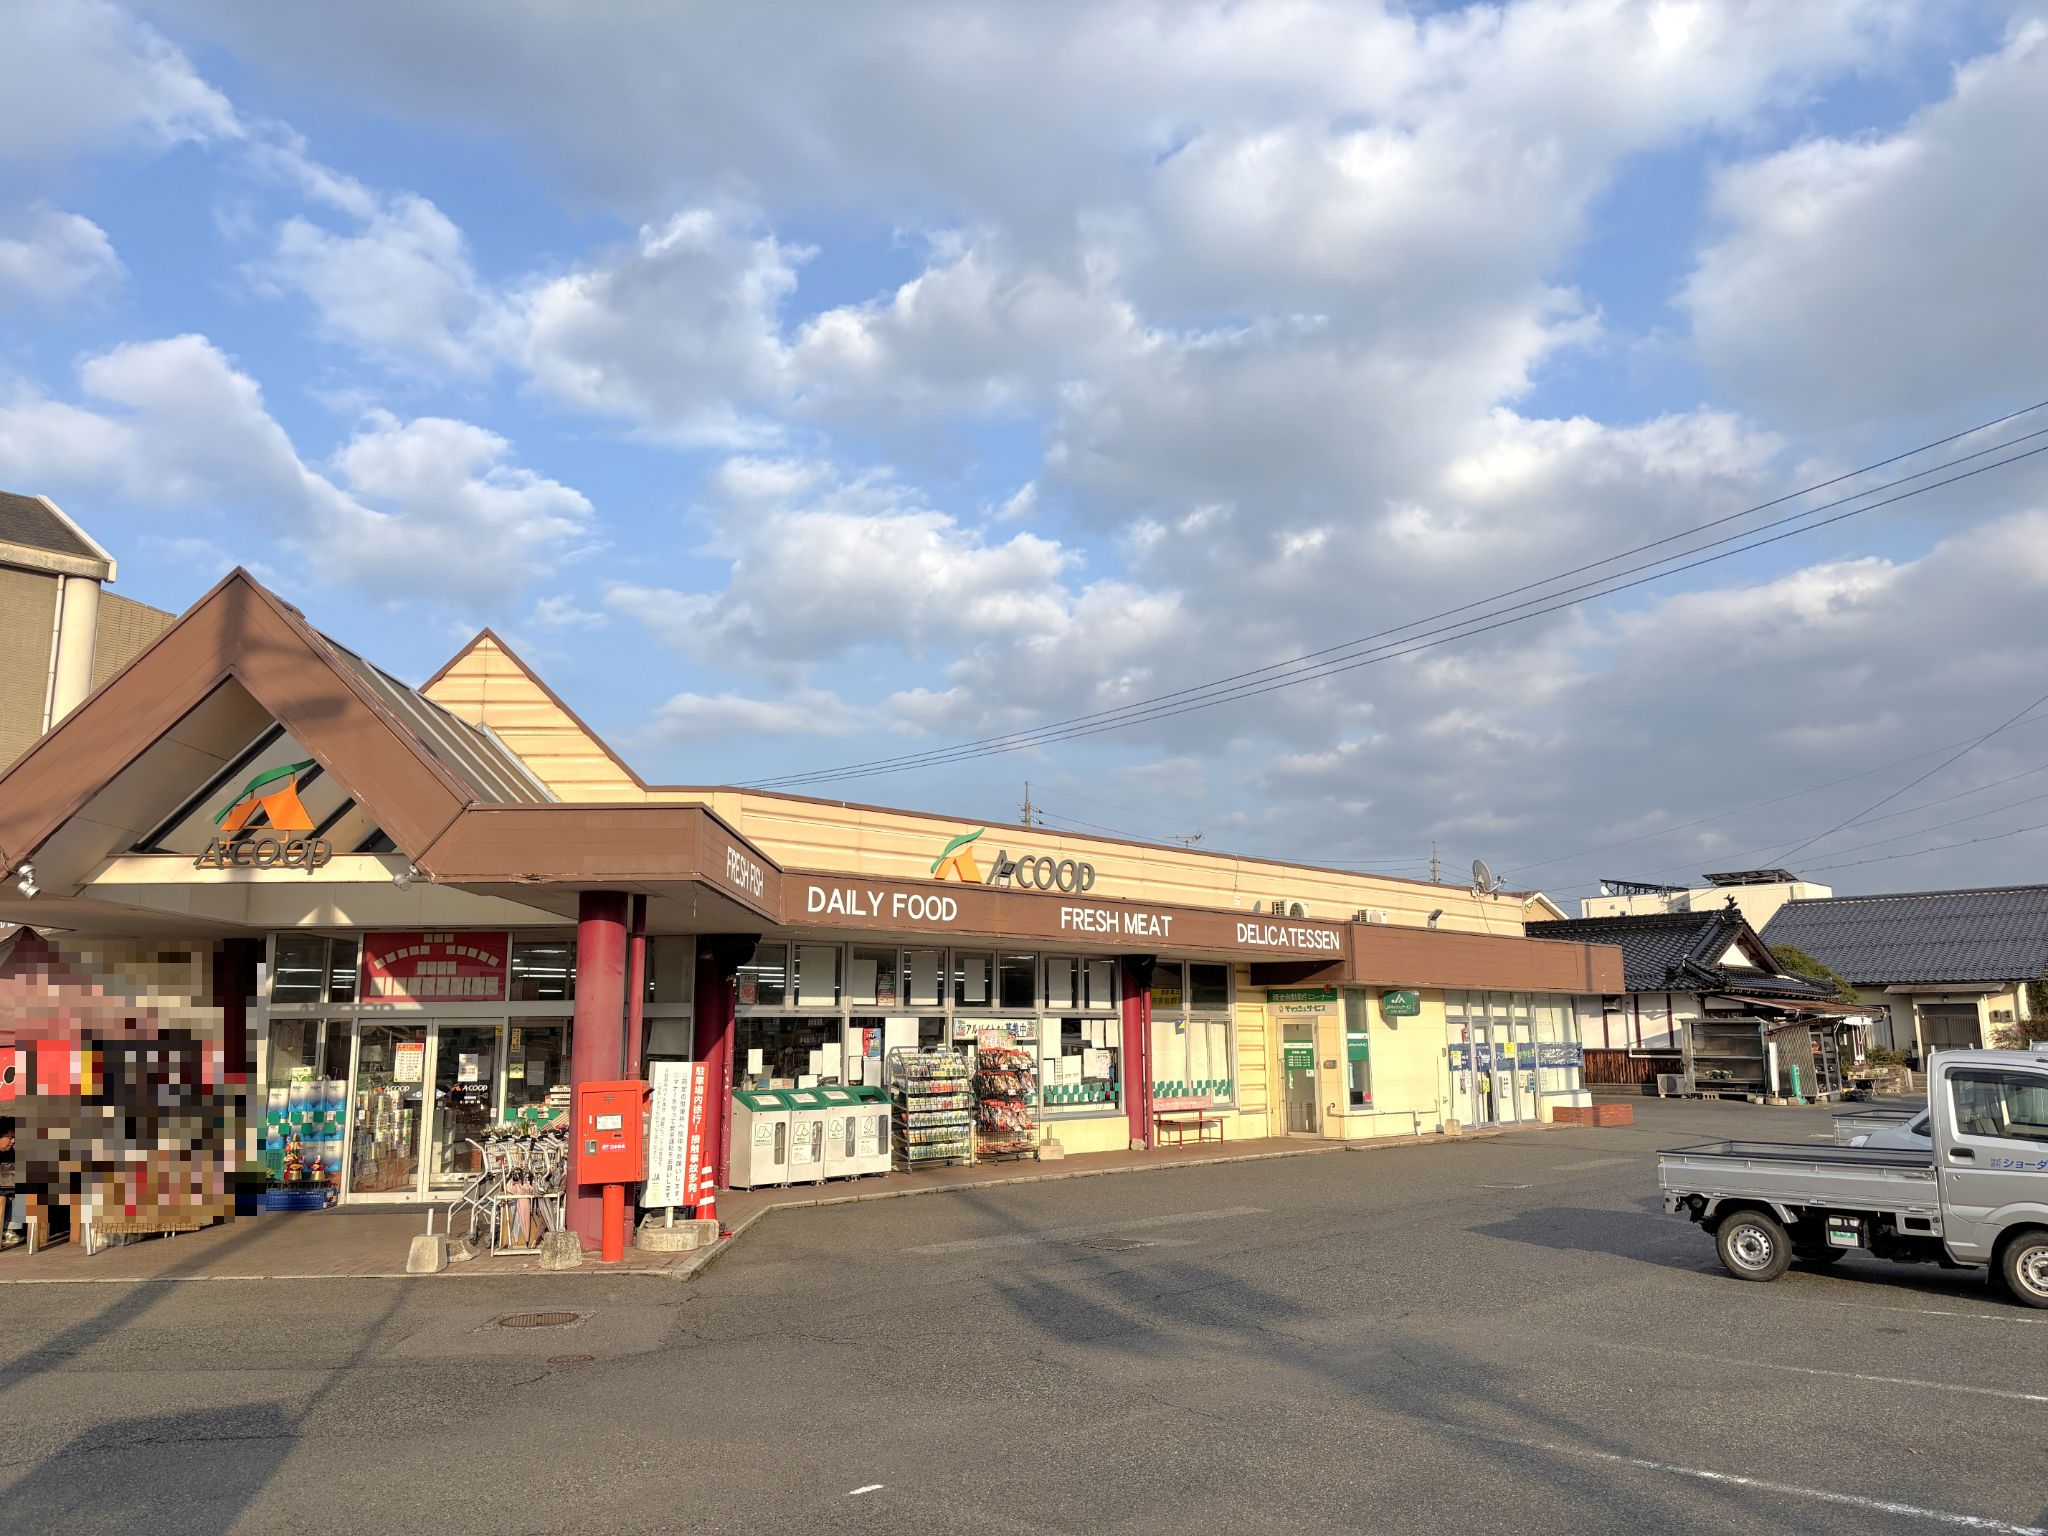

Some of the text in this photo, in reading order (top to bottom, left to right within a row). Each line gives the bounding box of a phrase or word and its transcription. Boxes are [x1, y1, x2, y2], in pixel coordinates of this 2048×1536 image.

[726, 845, 765, 899] FRESH FISH
[807, 886, 958, 922] DAILY FOOD
[1060, 906, 1173, 937] FRESH MEAT
[1236, 922, 1340, 950] DELICATESSEN
